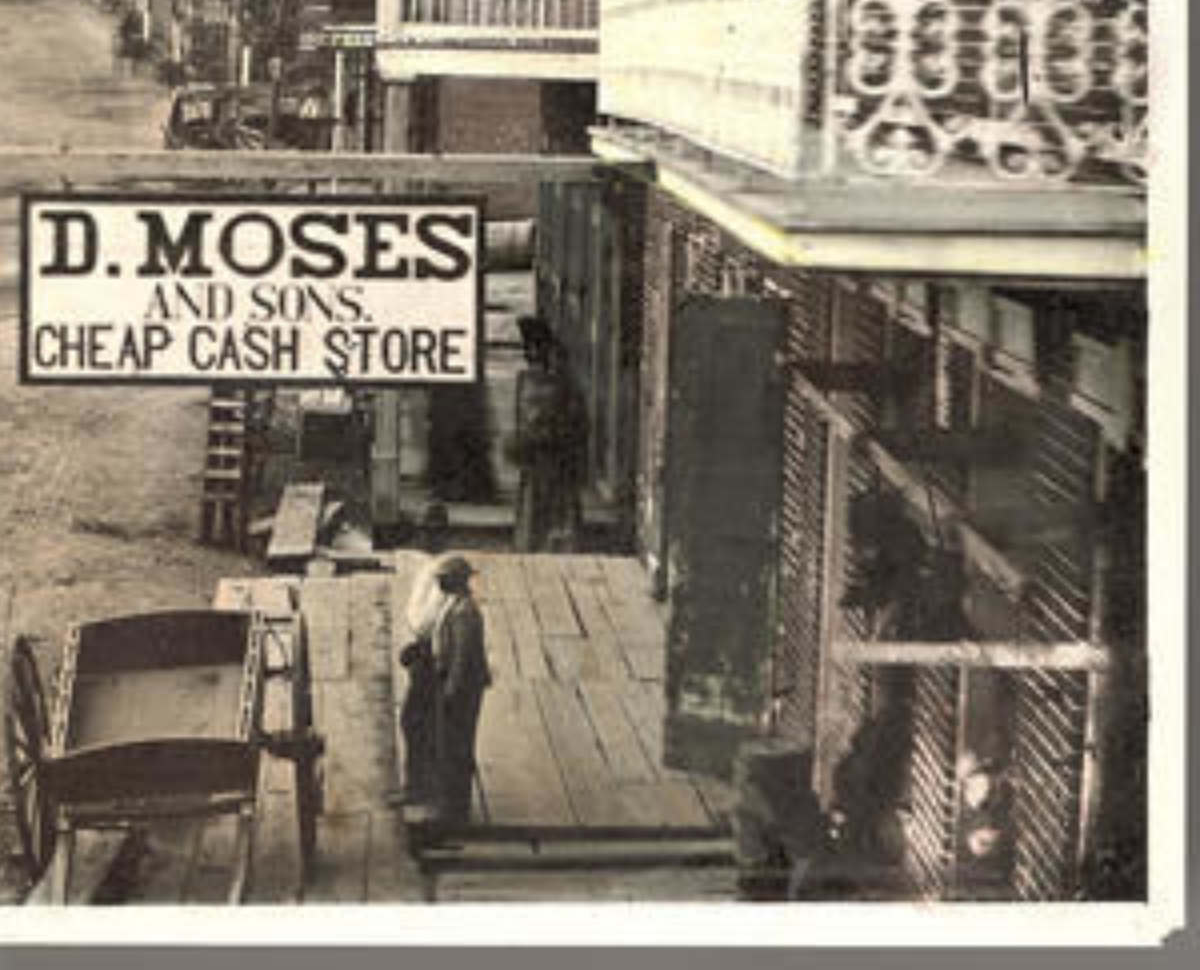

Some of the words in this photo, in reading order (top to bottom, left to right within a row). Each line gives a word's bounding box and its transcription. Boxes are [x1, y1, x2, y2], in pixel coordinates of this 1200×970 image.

[39, 210, 121, 277] D.
[136, 211, 473, 280] MOSES
[144, 282, 234, 320] AND
[248, 283, 373, 323] SONS.
[35, 324, 173, 370] CHEAP
[188, 325, 299, 371] CASH
[323, 327, 467, 375] STORE
